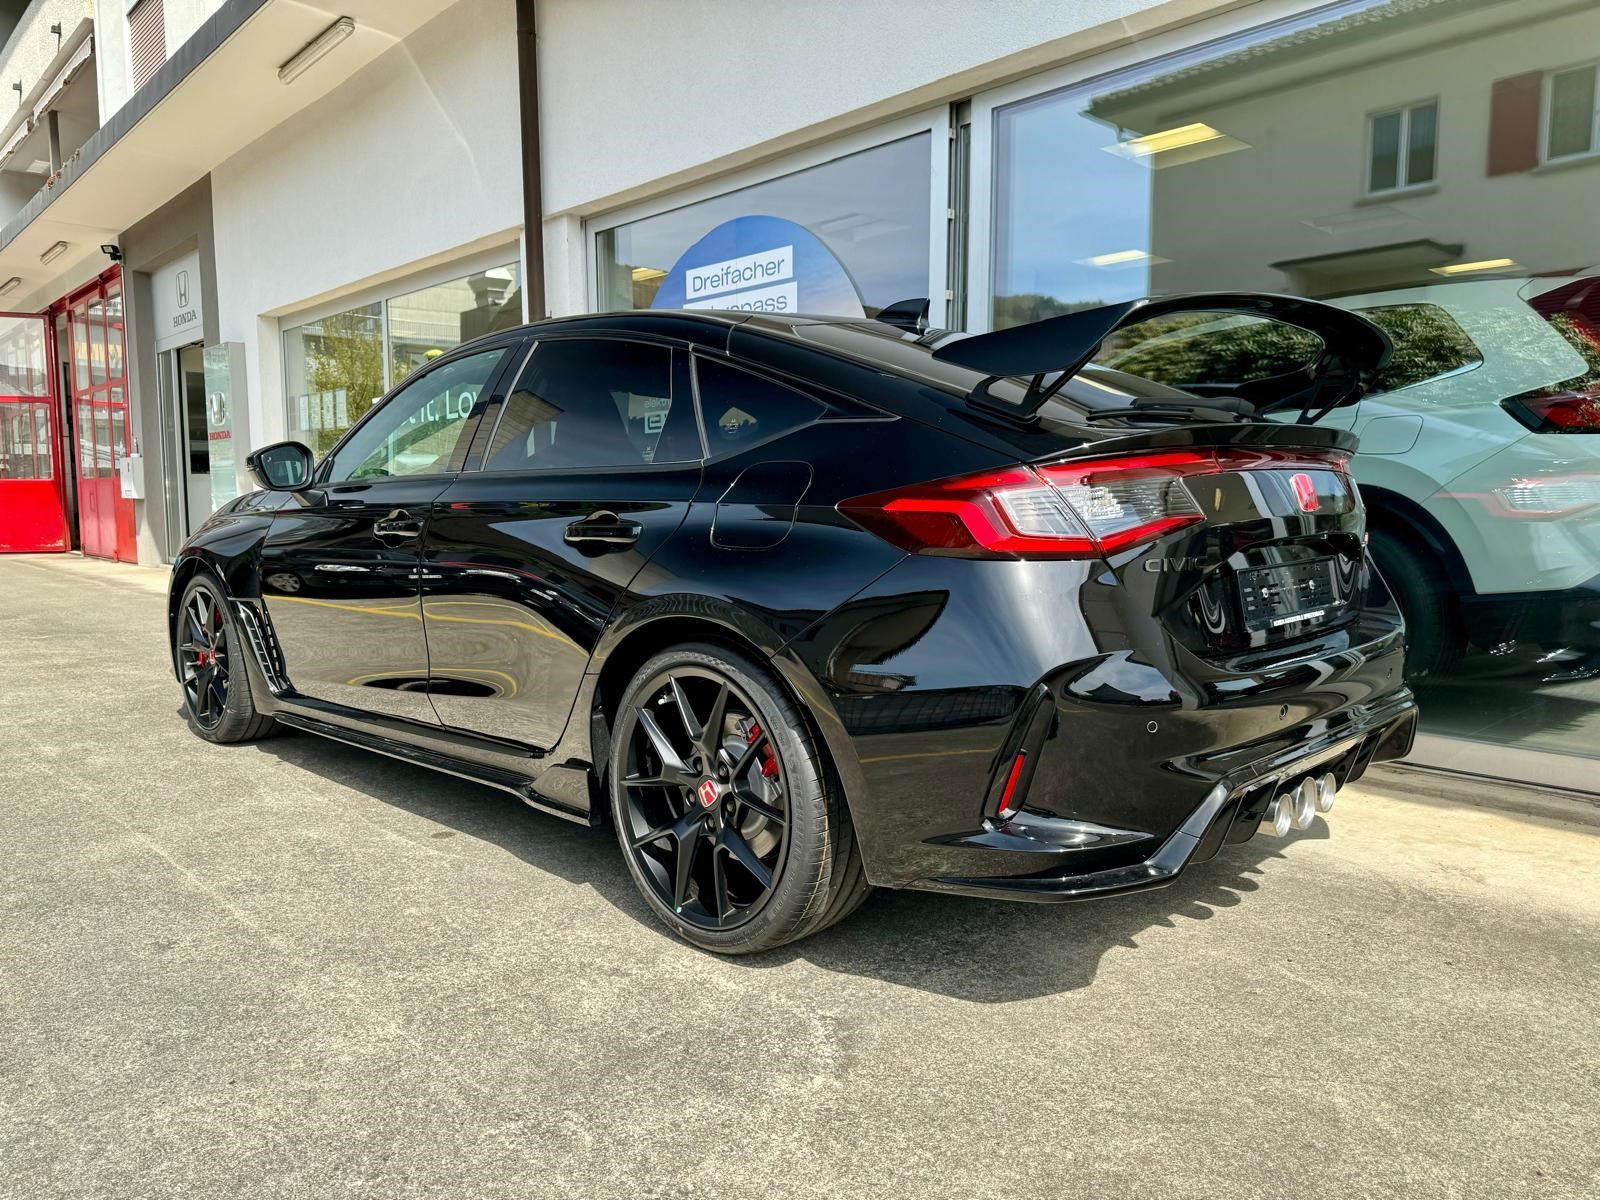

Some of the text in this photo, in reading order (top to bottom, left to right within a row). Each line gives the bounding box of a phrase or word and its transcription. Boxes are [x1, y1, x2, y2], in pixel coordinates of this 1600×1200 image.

[692, 258, 785, 292] Dreifacher
[173, 309, 197, 328] HONDA
[208, 430, 232, 441] HONDA
[1144, 556, 1208, 573] CIVIC
